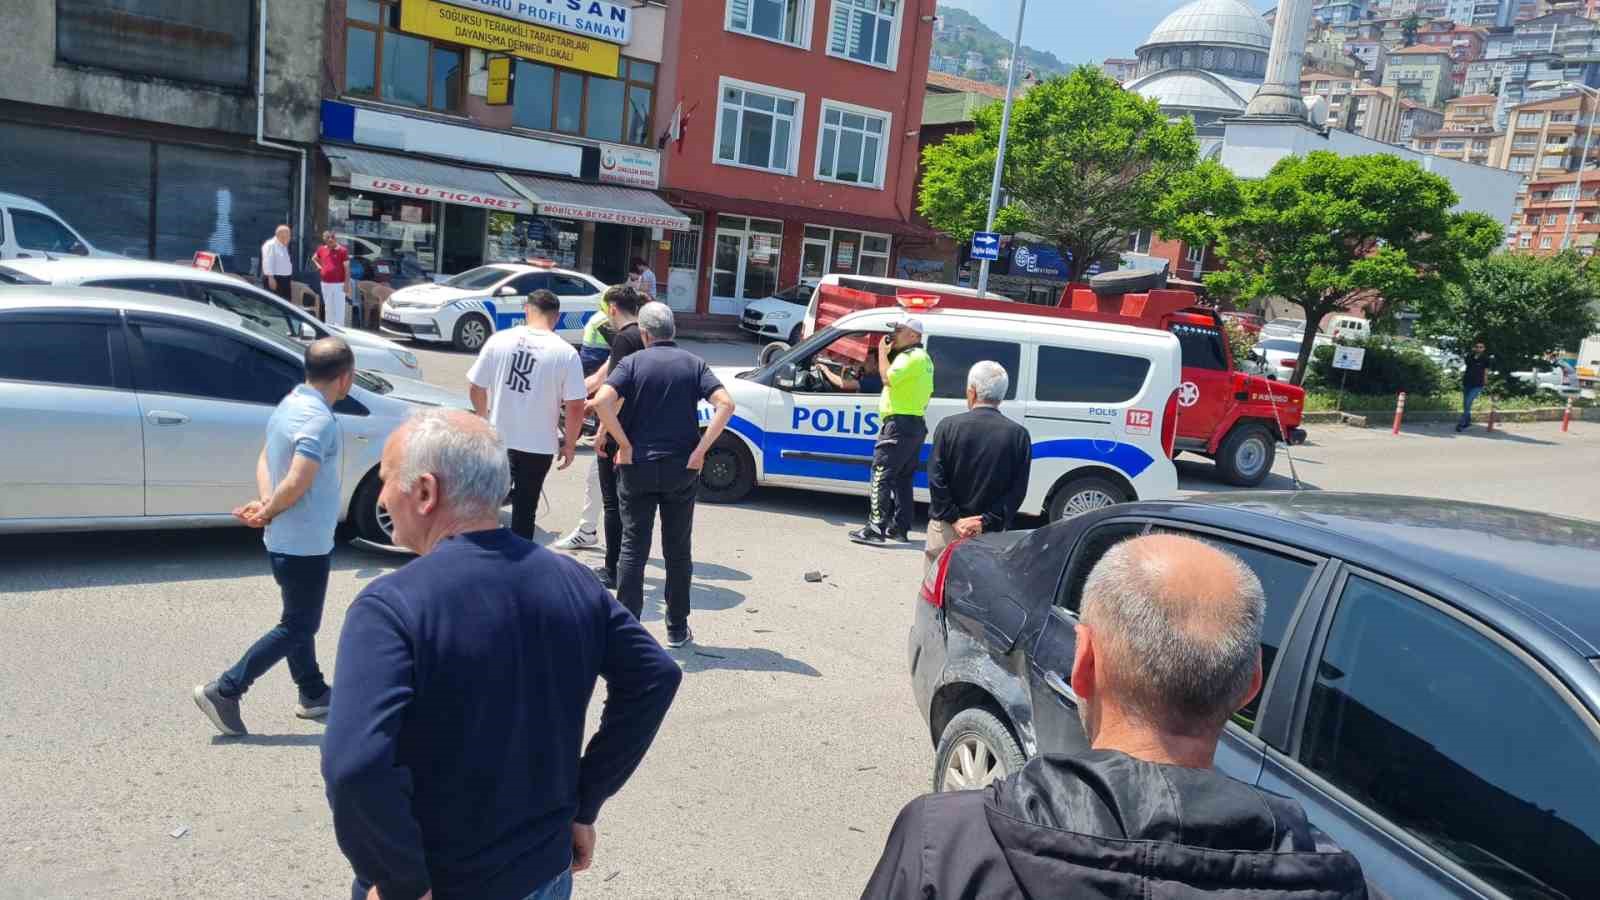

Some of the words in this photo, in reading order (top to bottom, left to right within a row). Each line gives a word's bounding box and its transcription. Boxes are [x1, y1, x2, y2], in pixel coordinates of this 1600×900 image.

[440, 8, 481, 27] SOĞUKSU
[518, 3, 568, 26] PROFİL
[456, 26, 506, 46] DAYANIŞMA
[372, 180, 429, 195] USLU
[792, 405, 880, 435] POLİS
[1130, 411, 1150, 425] 112
